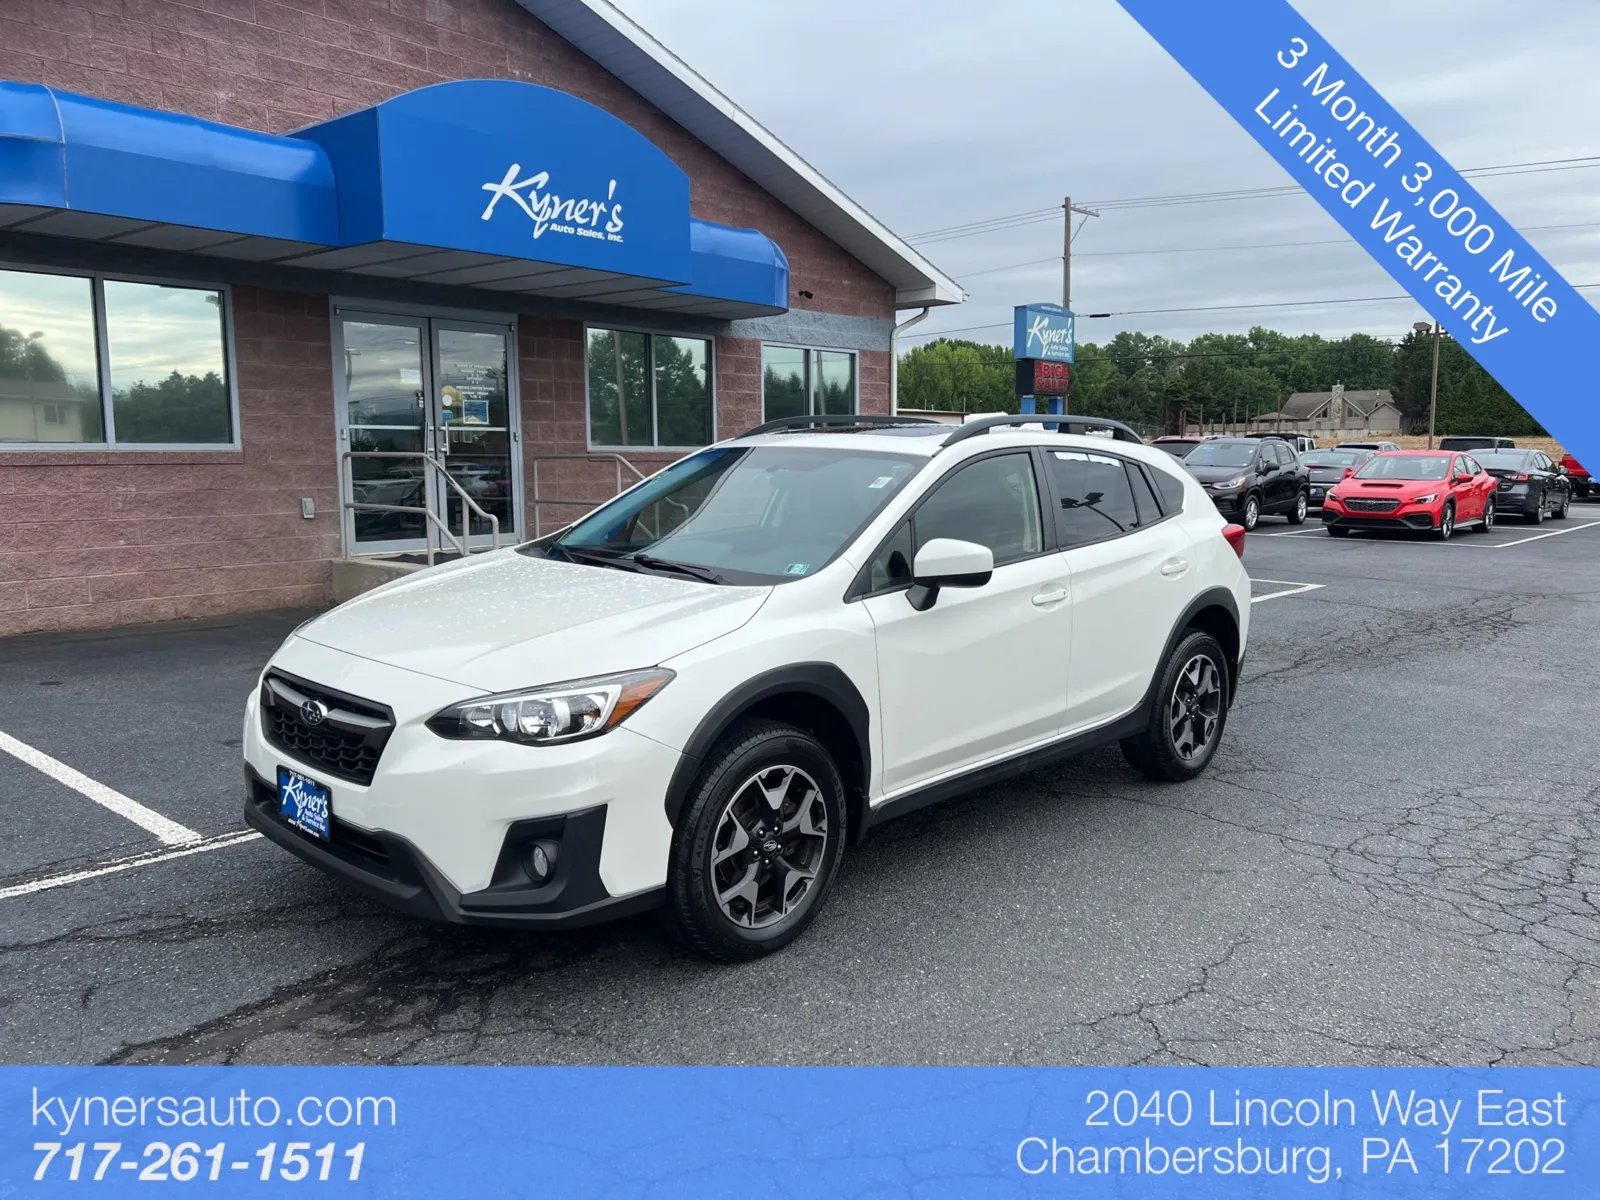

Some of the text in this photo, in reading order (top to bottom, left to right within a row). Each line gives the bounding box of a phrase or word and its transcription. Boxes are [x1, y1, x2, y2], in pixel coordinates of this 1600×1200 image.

[481, 162, 624, 240] Kyner's
[549, 222, 625, 243] Auto Sales, Inc.
[1026, 314, 1073, 359] Kyner's
[1043, 363, 1063, 378] BIG
[282, 775, 329, 819] Kyner's
